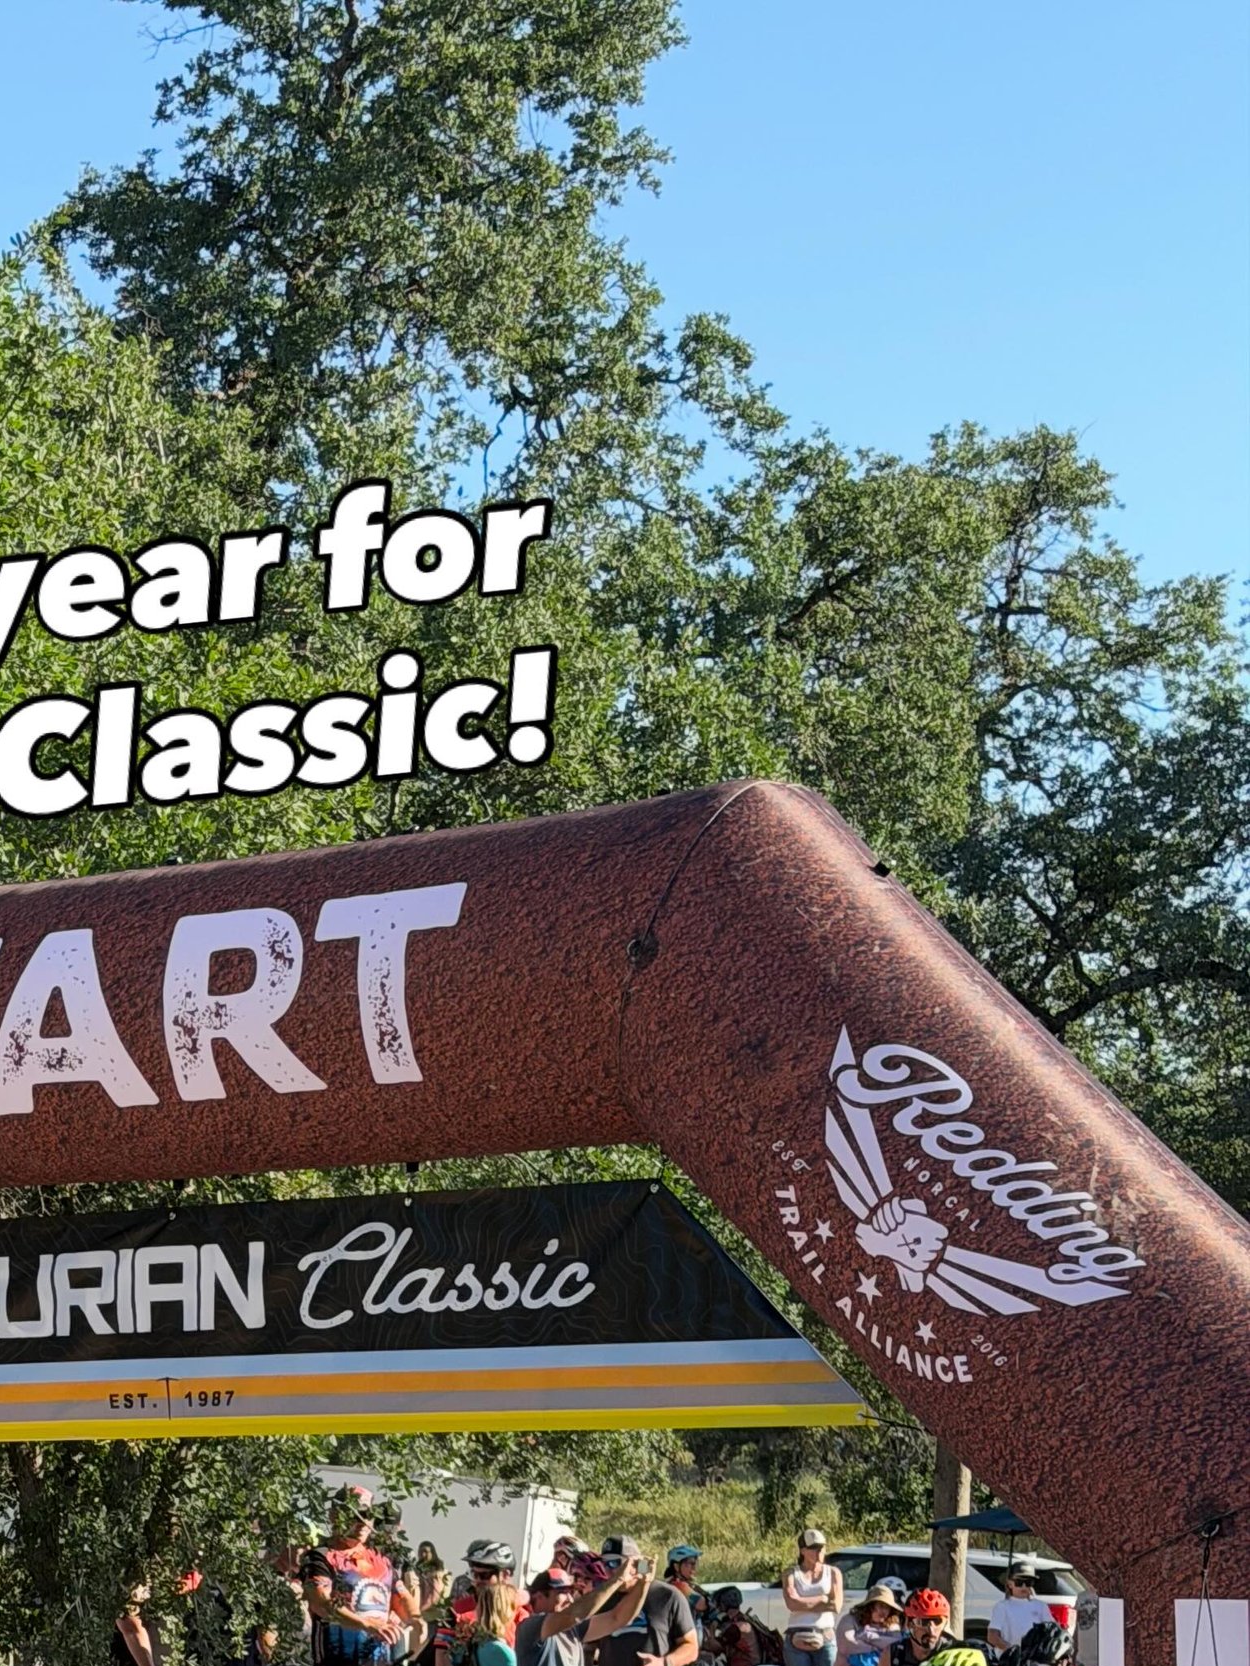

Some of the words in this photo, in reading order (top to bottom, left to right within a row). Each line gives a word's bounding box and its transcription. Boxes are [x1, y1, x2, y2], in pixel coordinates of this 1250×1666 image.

[837, 1044, 1147, 1284] Redding
[903, 1156, 980, 1232] NORCAL
[298, 1222, 596, 1329] Classic
[776, 1185, 826, 1286] TRAIL
[835, 1296, 973, 1384] ALLIANCE
[970, 1334, 1008, 1368] 2016
[109, 1391, 158, 1410] EST.
[184, 1389, 235, 1408] 1987
